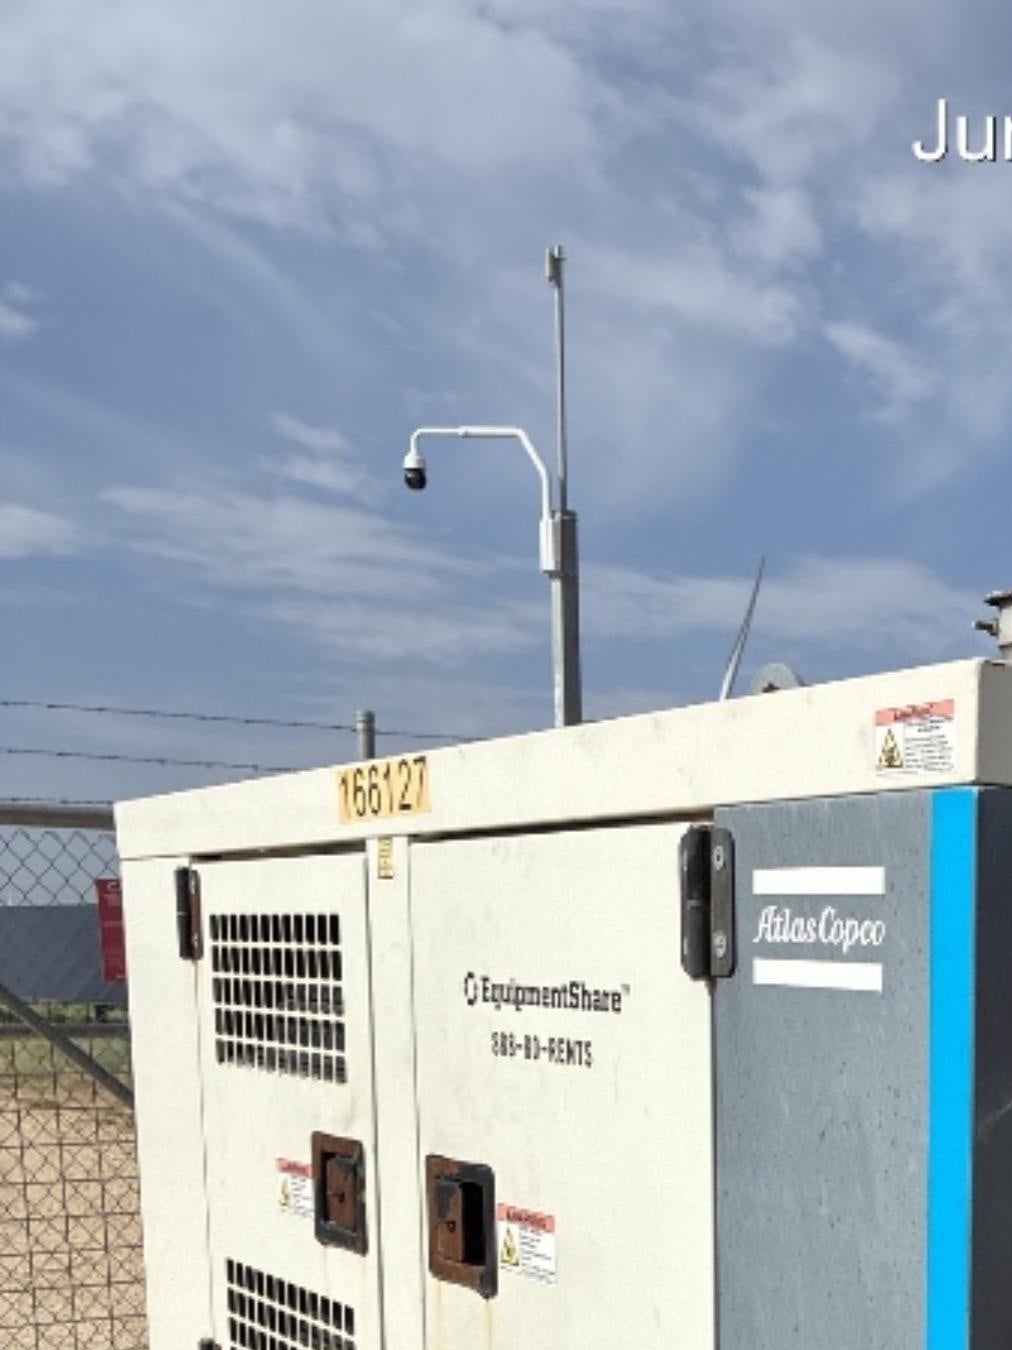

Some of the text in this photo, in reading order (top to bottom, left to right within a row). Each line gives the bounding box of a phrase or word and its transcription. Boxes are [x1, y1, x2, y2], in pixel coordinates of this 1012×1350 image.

[340, 755, 427, 819] 166127
[752, 904, 887, 955] Atlas Copco
[480, 974, 622, 1015] EquipmentShare
